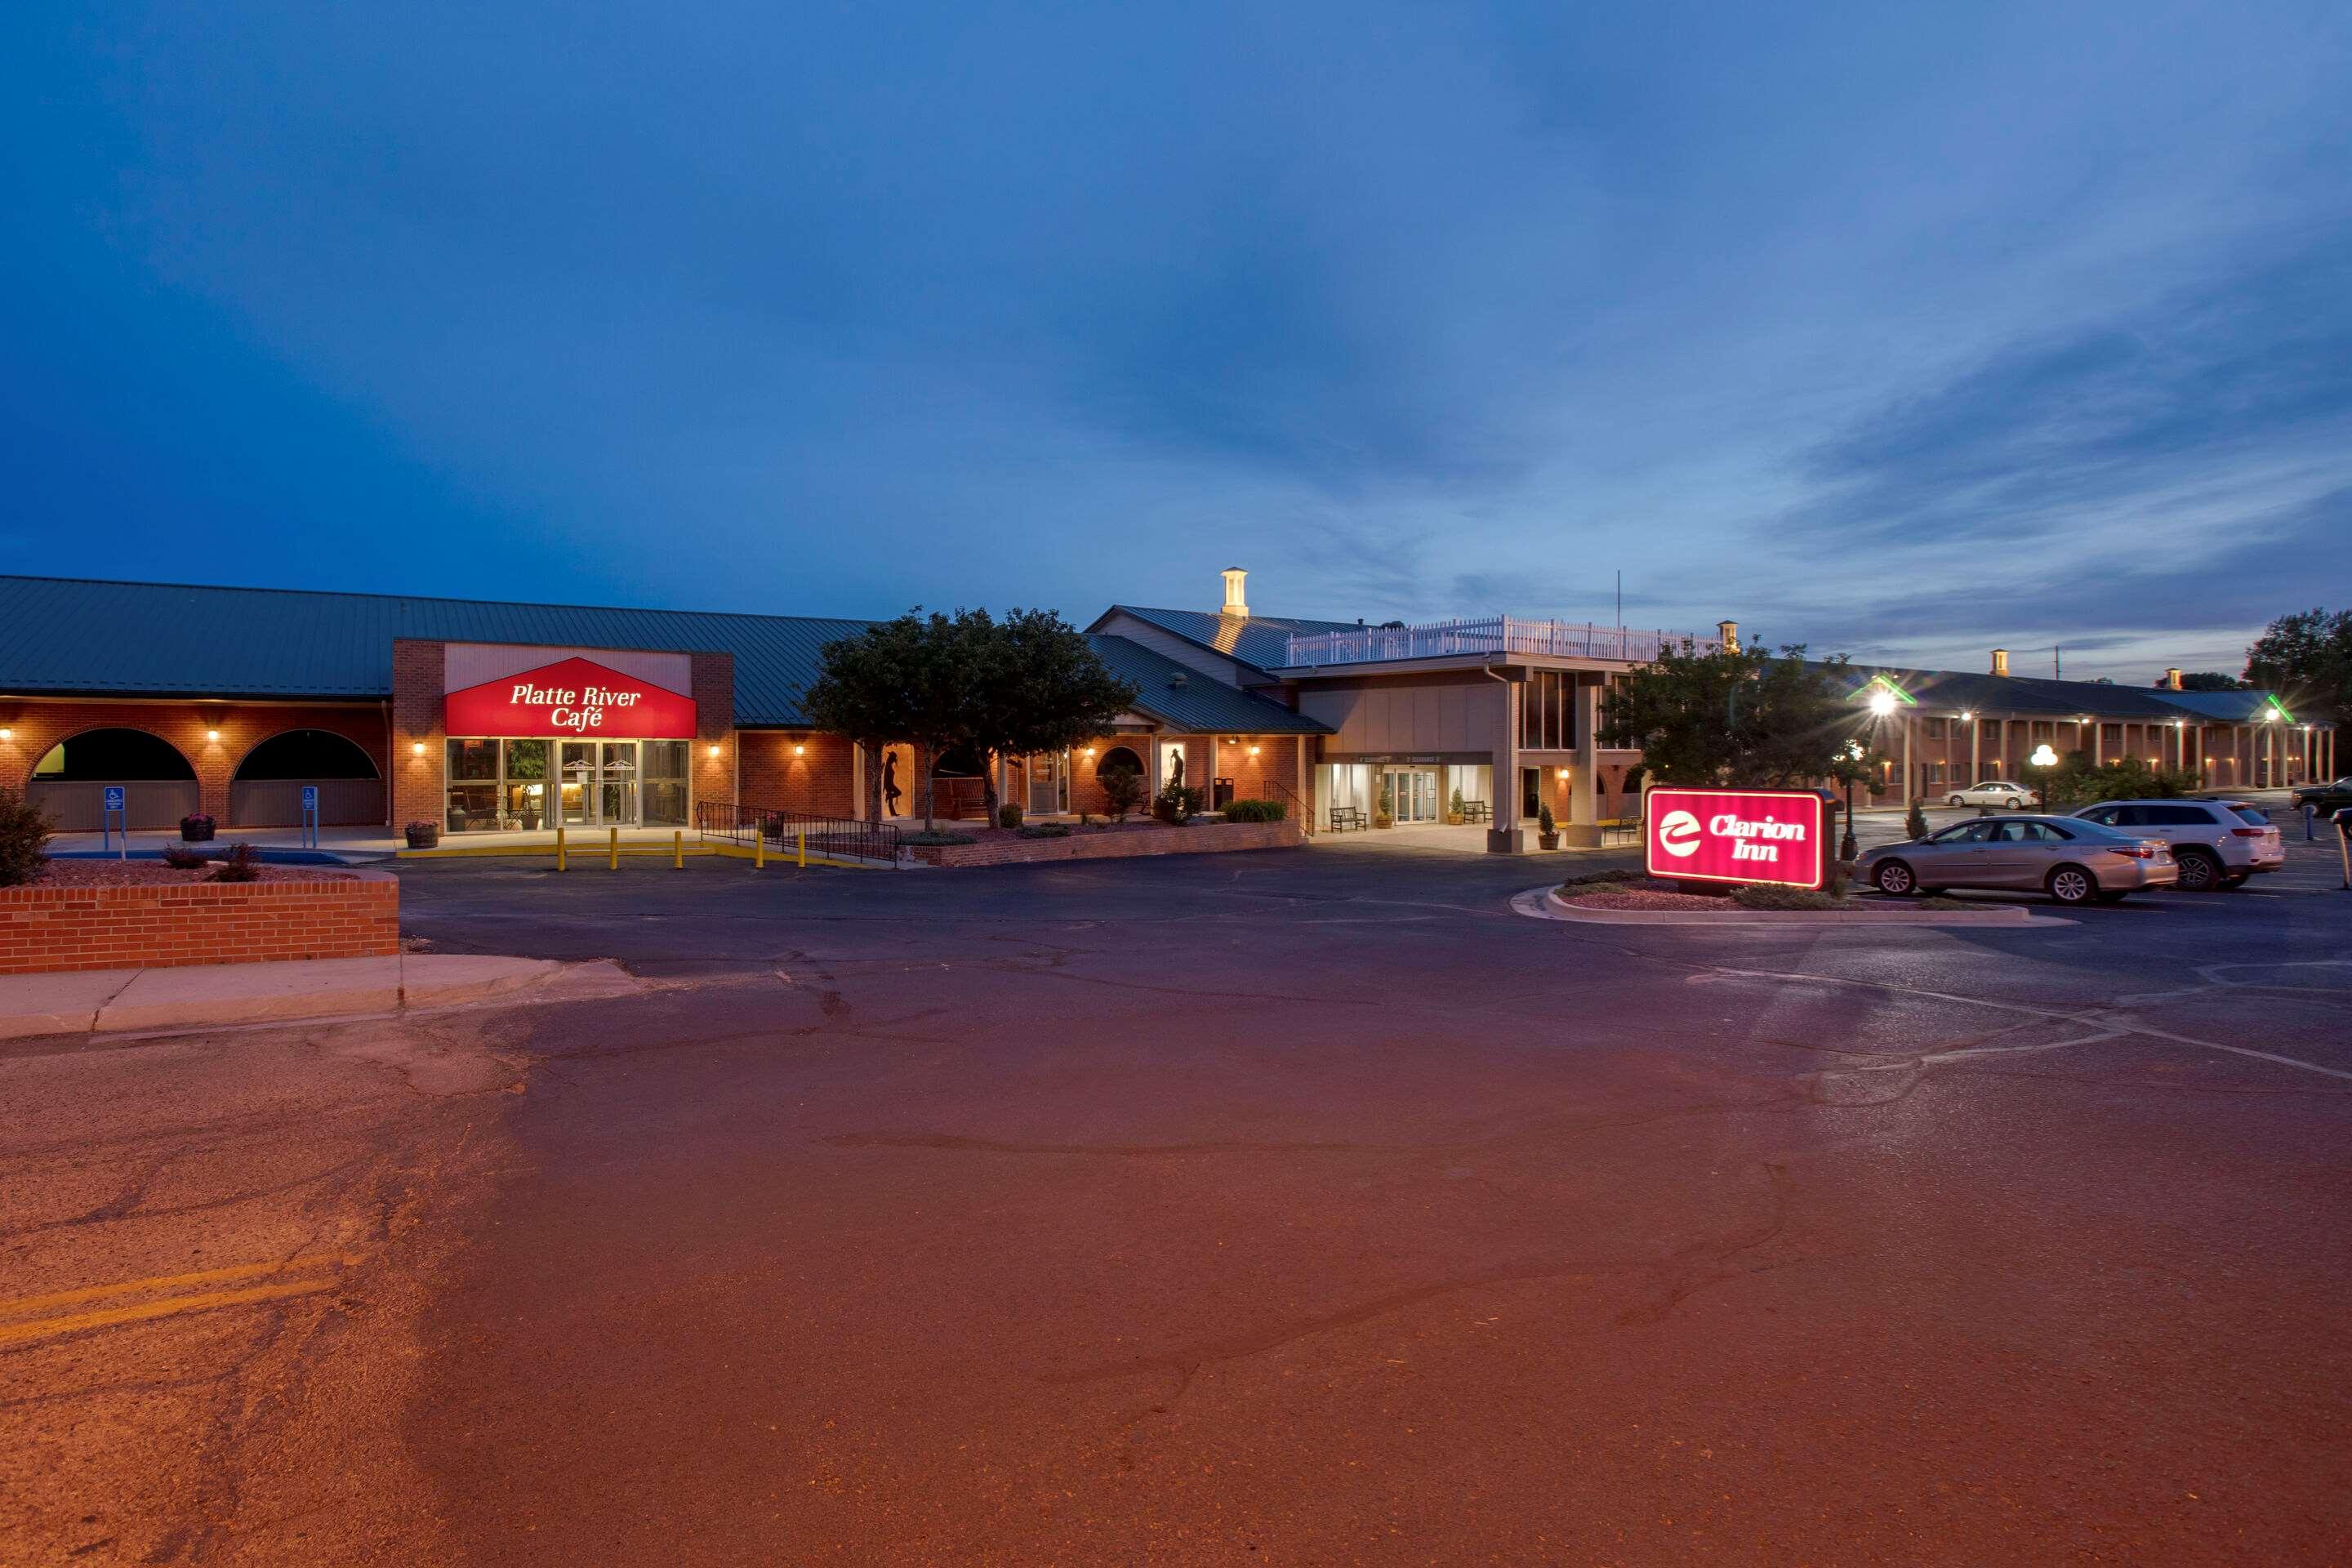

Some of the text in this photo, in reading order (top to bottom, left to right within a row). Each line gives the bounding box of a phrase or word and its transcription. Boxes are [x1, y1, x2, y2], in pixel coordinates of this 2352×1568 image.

[510, 684, 641, 706] Platte River
[551, 706, 603, 732] Café
[1709, 814, 1806, 841] Clarion
[1731, 838, 1778, 862] Inn
